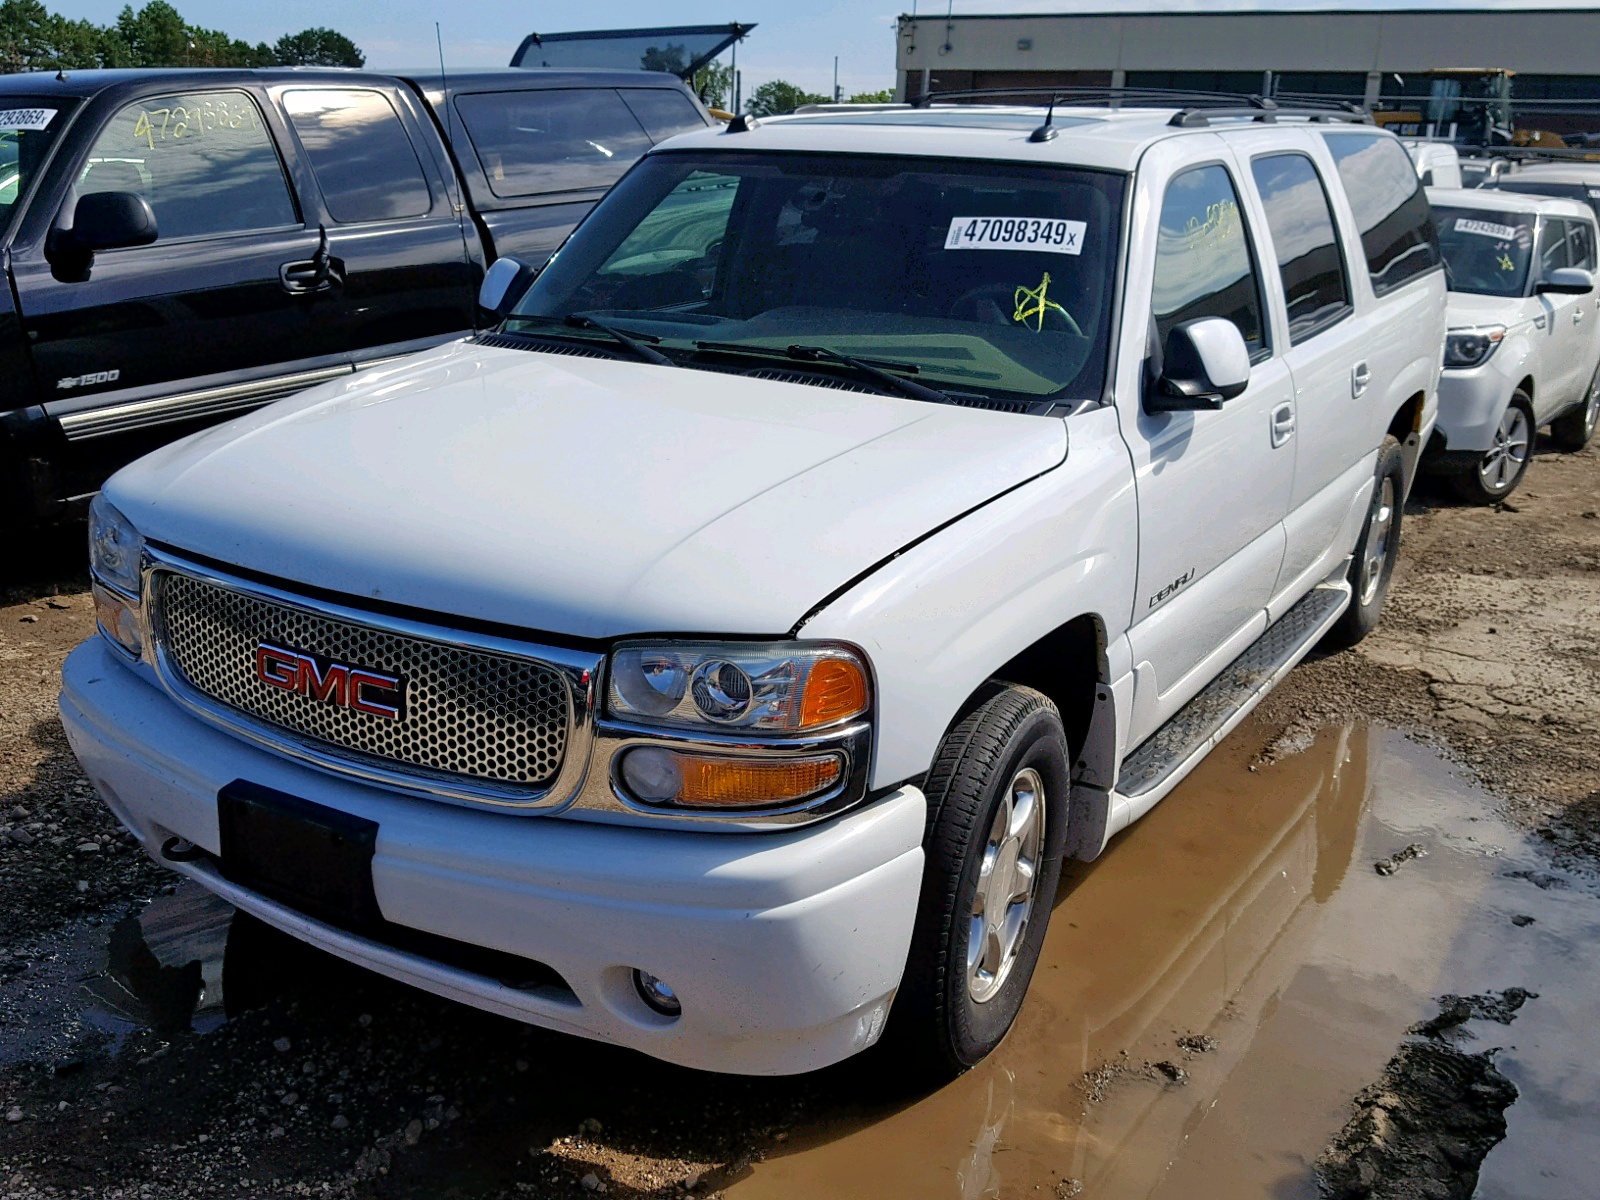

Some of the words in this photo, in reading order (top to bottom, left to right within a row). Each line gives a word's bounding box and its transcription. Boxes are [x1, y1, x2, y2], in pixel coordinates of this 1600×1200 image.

[80, 369, 120, 387] 1500
[1148, 567, 1195, 609] DENALI
[256, 643, 400, 721] GMC
